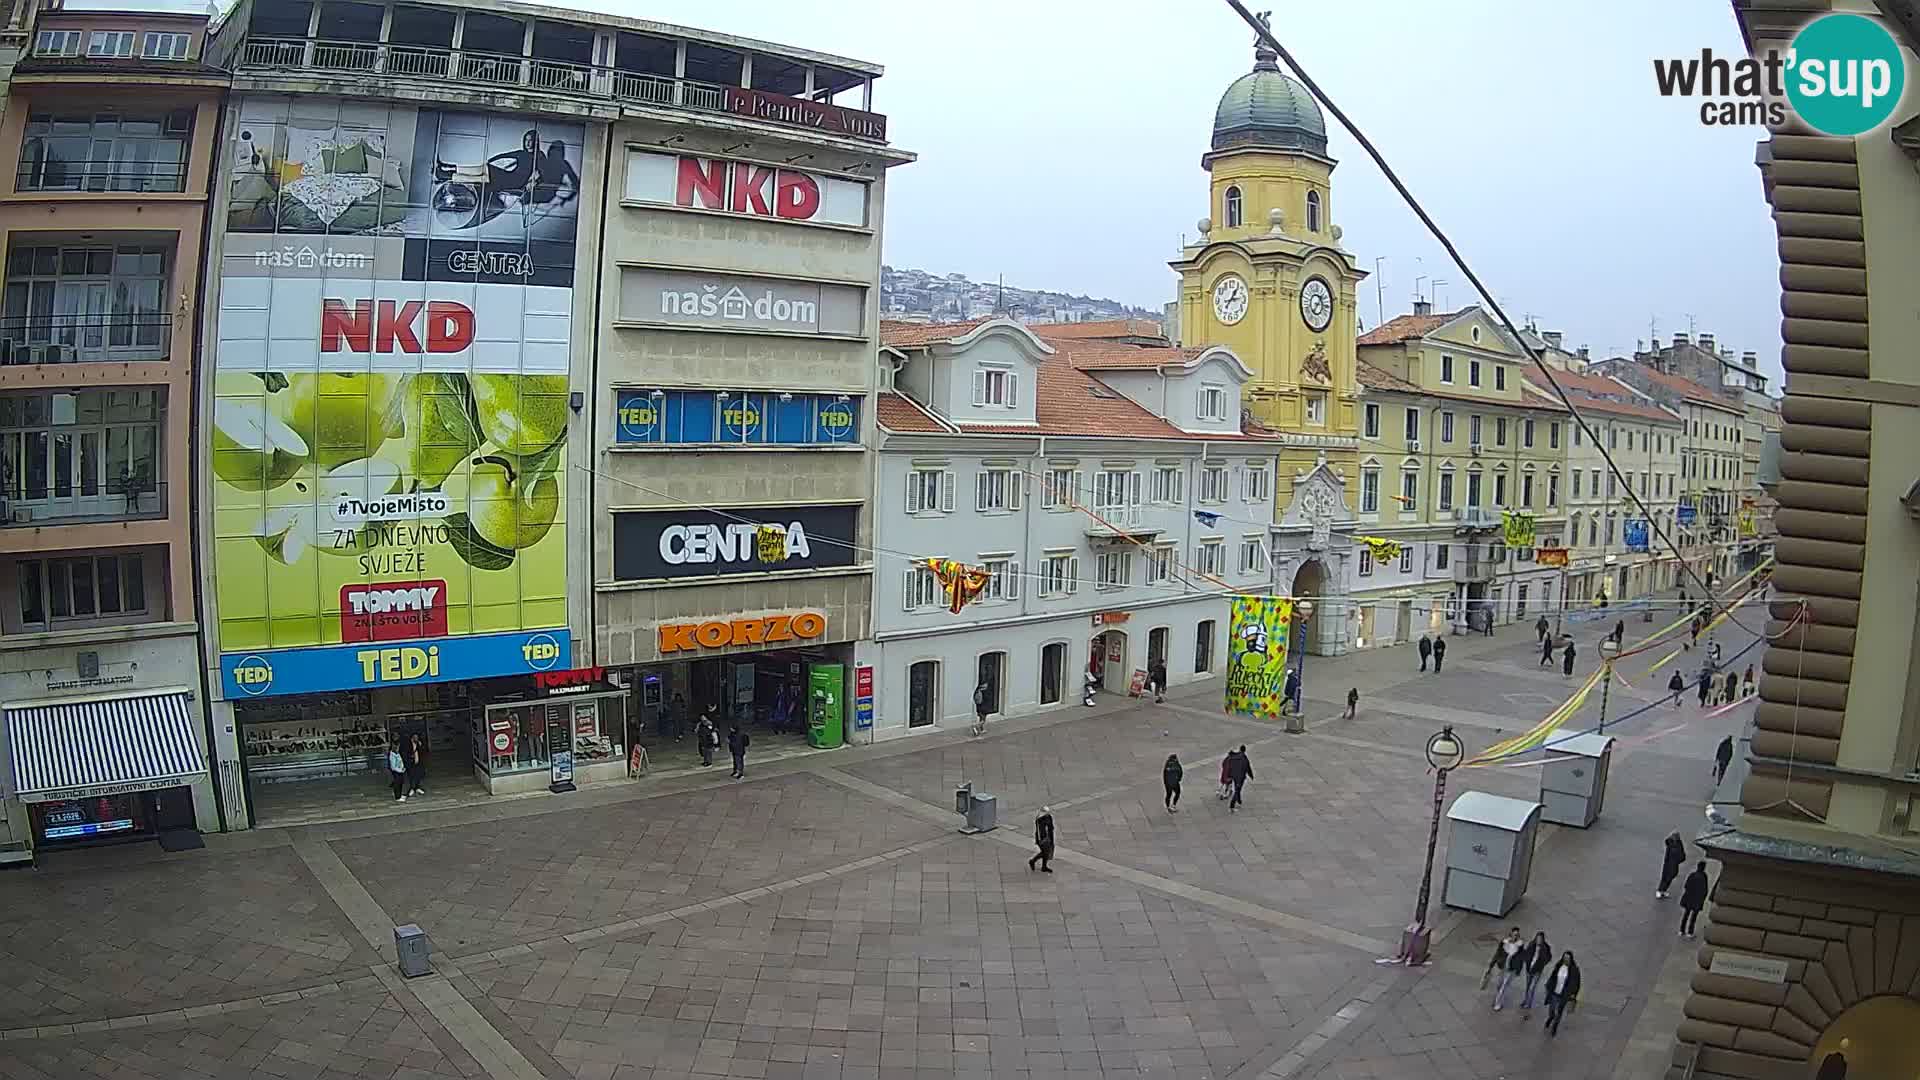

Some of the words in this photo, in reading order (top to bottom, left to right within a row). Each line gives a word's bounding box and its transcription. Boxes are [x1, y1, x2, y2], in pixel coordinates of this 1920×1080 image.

[676, 157, 820, 219] NKD
[255, 247, 294, 267] naš
[319, 248, 365, 269] dom
[448, 250, 535, 275] CENTRA
[661, 284, 718, 317] naš
[754, 290, 816, 324] dom
[320, 298, 477, 354] NKD
[618, 408, 657, 426] TEDi
[723, 409, 760, 427] TEDi
[820, 411, 853, 427] TEDi
[338, 497, 446, 517] #TvojeMisto
[333, 529, 357, 549] ZA
[365, 524, 451, 549] DNEVNO
[659, 521, 811, 565] CENTA
[359, 548, 426, 576] SVJEŽE
[348, 586, 440, 615] TOMMY
[378, 614, 400, 626] ŠTO
[659, 612, 826, 654] KORZO
[521, 641, 560, 660] TEDi
[233, 665, 273, 684] TEDi
[357, 645, 440, 683] TEDi
